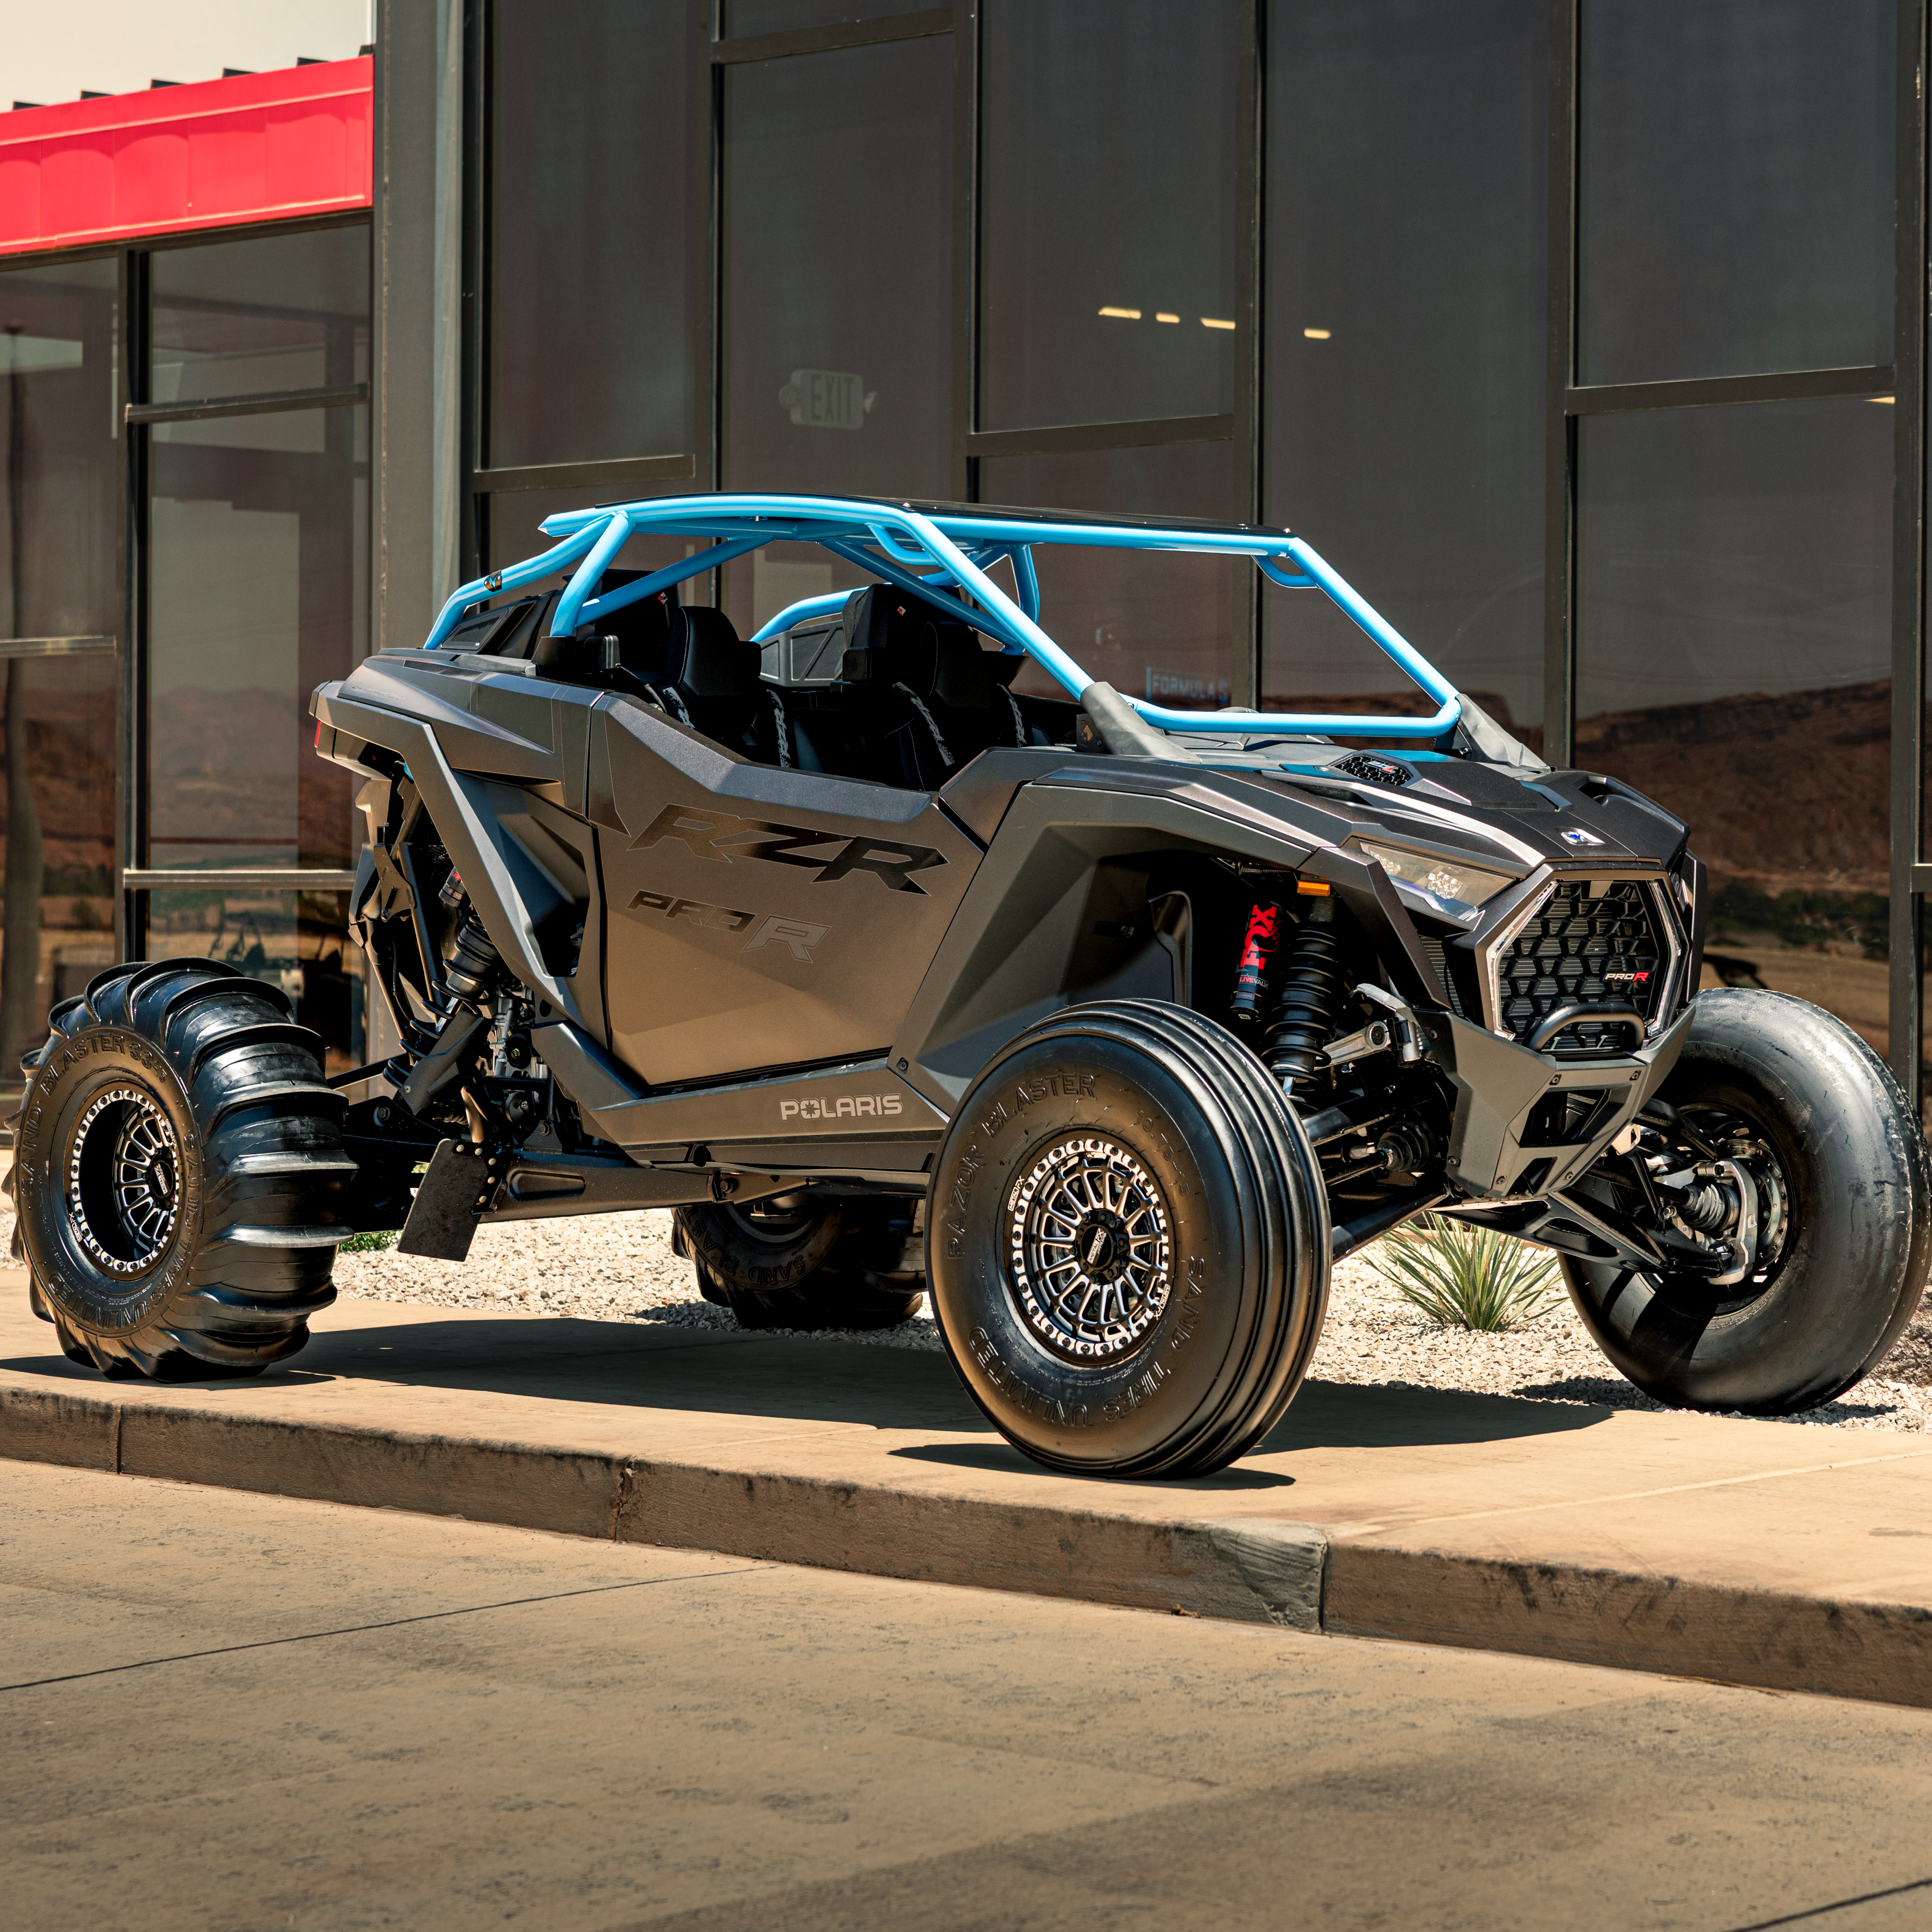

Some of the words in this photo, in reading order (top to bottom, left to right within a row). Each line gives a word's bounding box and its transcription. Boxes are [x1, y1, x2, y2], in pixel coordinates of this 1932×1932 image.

[810, 373, 855, 423] EXIT
[1152, 675, 1216, 700] FORMULA
[774, 708, 791, 759] RZR
[627, 803, 950, 897] RZR
[626, 889, 757, 934] PRO
[740, 914, 832, 964] R
[1240, 904, 1282, 970] FOX
[21, 1105, 42, 1196] SAND
[41, 1033, 125, 1096] BLASTER
[780, 1093, 903, 1121] POLARIS
[184, 1132, 199, 1228] SAND
[948, 1144, 983, 1259] RAZOR
[982, 1074, 1095, 1138] BLASTER
[1009, 1188, 1018, 1210] METAL
[683, 1206, 740, 1276] BLAST
[748, 1255, 806, 1286] SAND
[1089, 1242, 1099, 1262] METAL
[49, 1271, 149, 1328] UNLIMITED
[1160, 1286, 1170, 1305] METAL
[1172, 1256, 1205, 1349] SAND
[969, 1326, 1088, 1427] UNLIMITED
[1103, 1361, 1171, 1421] TIRES
